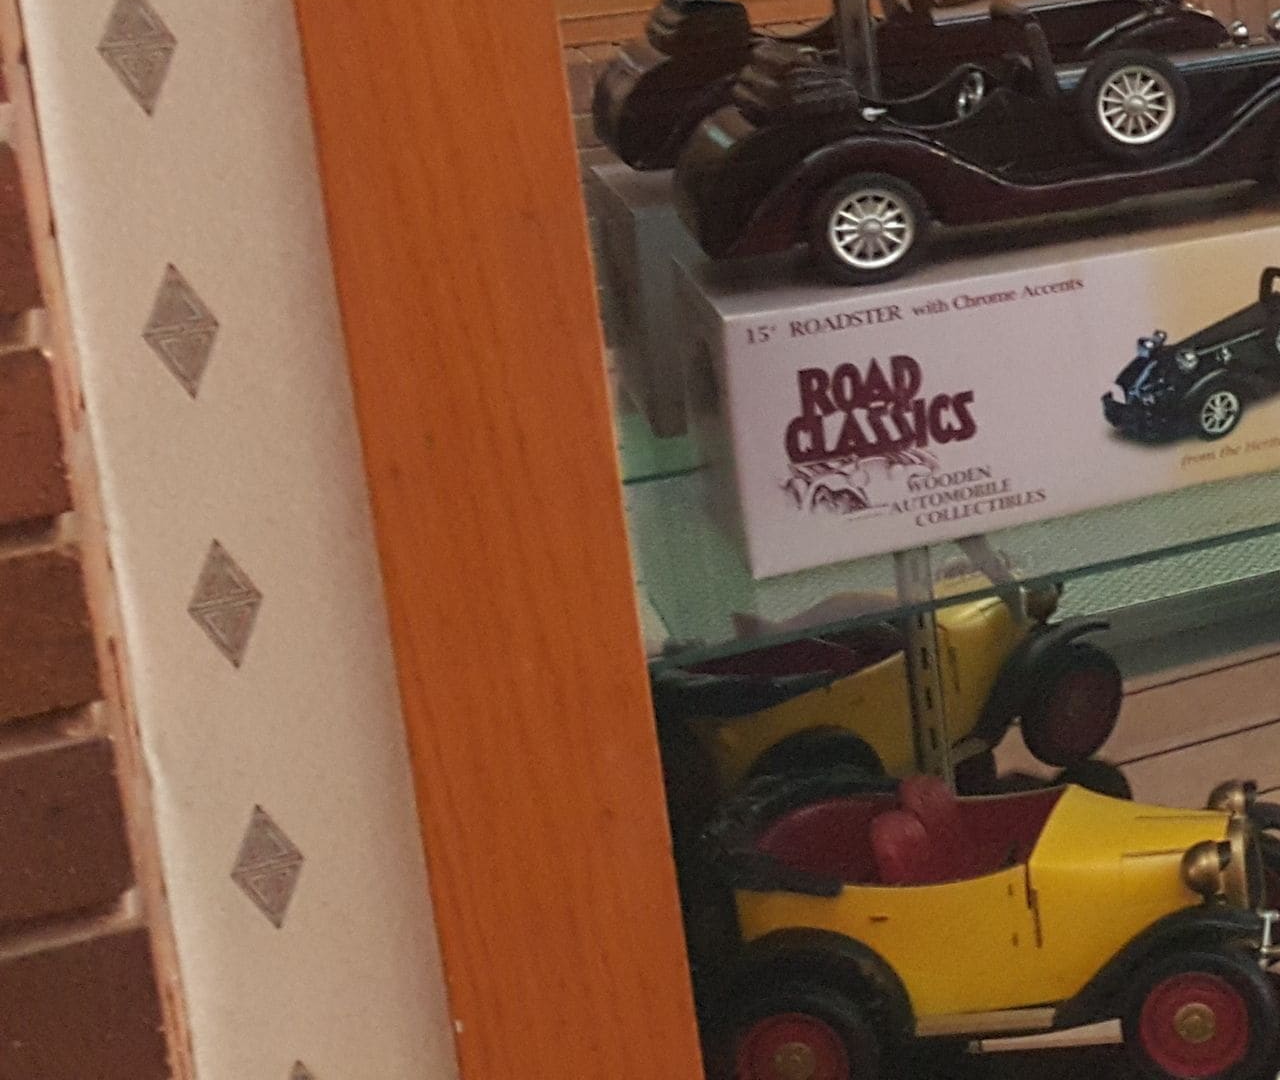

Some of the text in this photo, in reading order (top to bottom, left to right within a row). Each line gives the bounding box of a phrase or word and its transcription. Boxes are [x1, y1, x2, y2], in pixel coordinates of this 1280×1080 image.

[789, 305, 902, 338] ROADSTER
[911, 300, 951, 320] with
[953, 288, 1017, 312] Chrome
[1022, 277, 1086, 300] Accents
[797, 354, 923, 418] ROAD
[785, 389, 978, 462] CLASSICS
[890, 478, 1012, 514] AUTOMOBILE
[907, 464, 992, 494] WOODEN
[914, 489, 1047, 528] COLLECTIBLES
